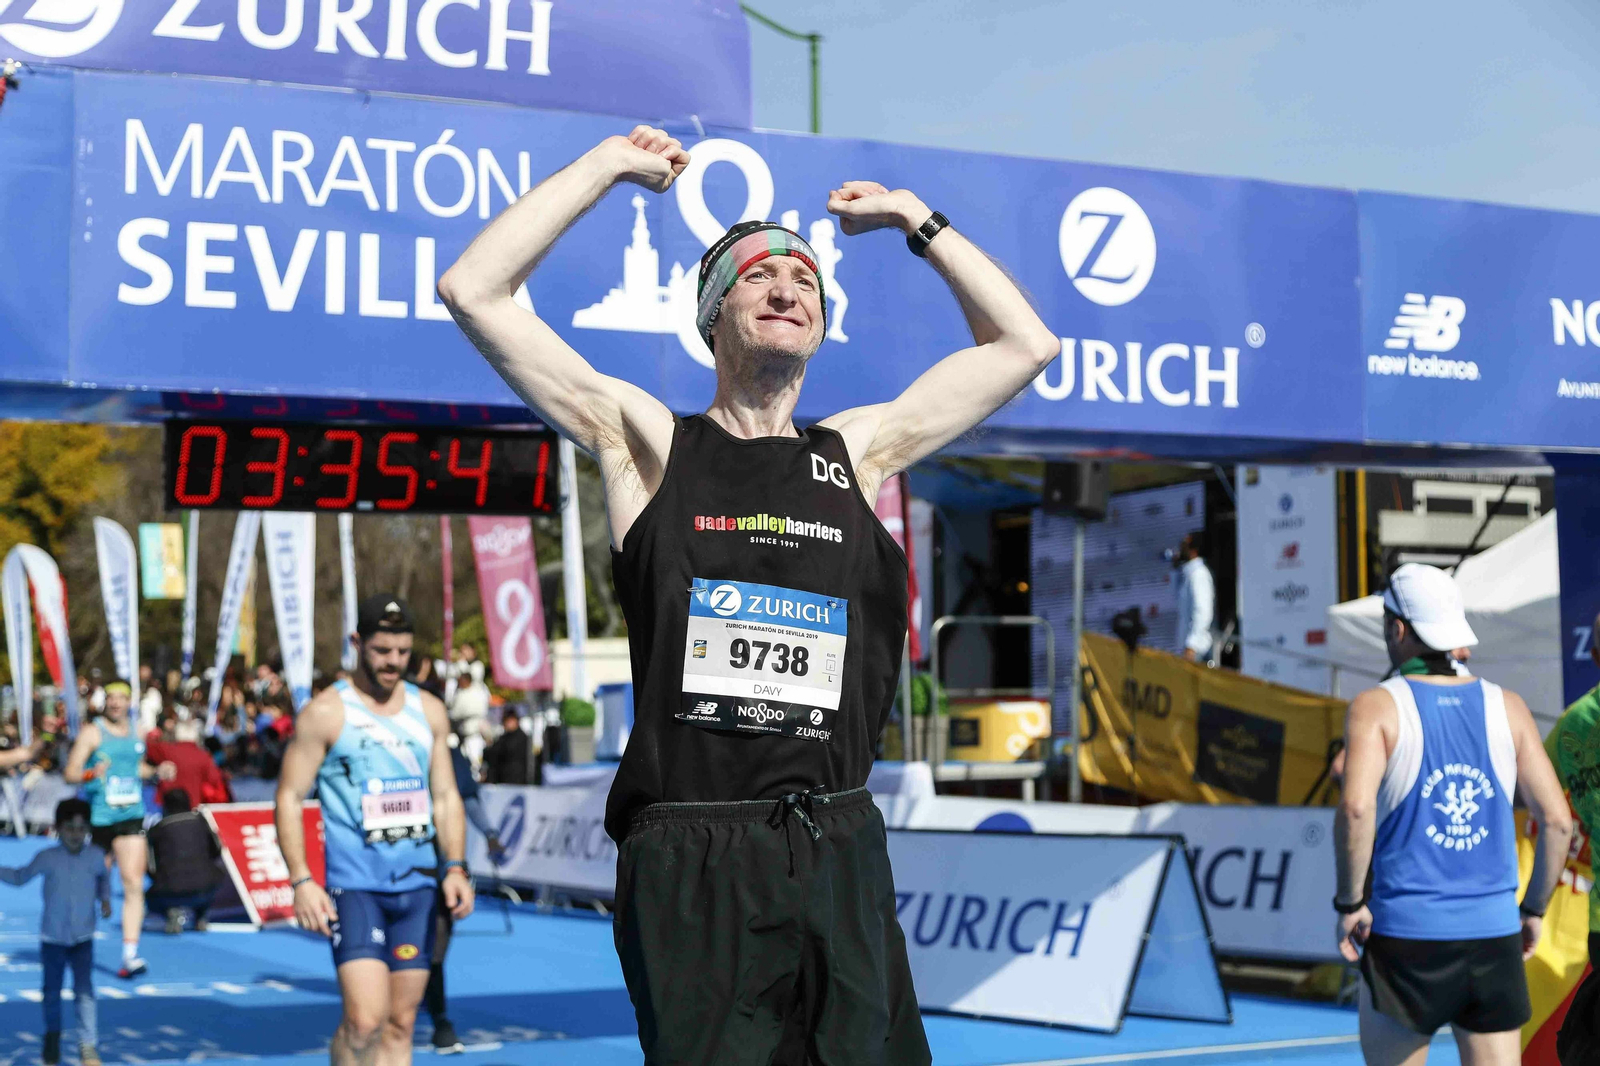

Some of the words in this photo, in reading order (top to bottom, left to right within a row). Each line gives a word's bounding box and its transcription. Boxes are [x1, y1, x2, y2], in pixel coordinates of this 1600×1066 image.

[124, 119, 532, 219] MARATÓN
[117, 217, 537, 322] SEVILL
[1033, 337, 1241, 408] URICH
[1367, 354, 1407, 376] new
[1408, 353, 1481, 381] balance
[174, 425, 550, 510] 03:35:41
[811, 453, 850, 489] DG
[750, 536, 777, 545] SINCE
[780, 539, 799, 549] 1991
[747, 595, 831, 625] ZURICH
[725, 622, 747, 630] ZURICH
[729, 638, 809, 677] 9738
[753, 684, 783, 697] DAVY
[698, 714, 721, 722] balance
[795, 726, 832, 741] ZURICH
[1443, 762, 1496, 800] MARATON
[1425, 823, 1489, 852] BADAJOZ
